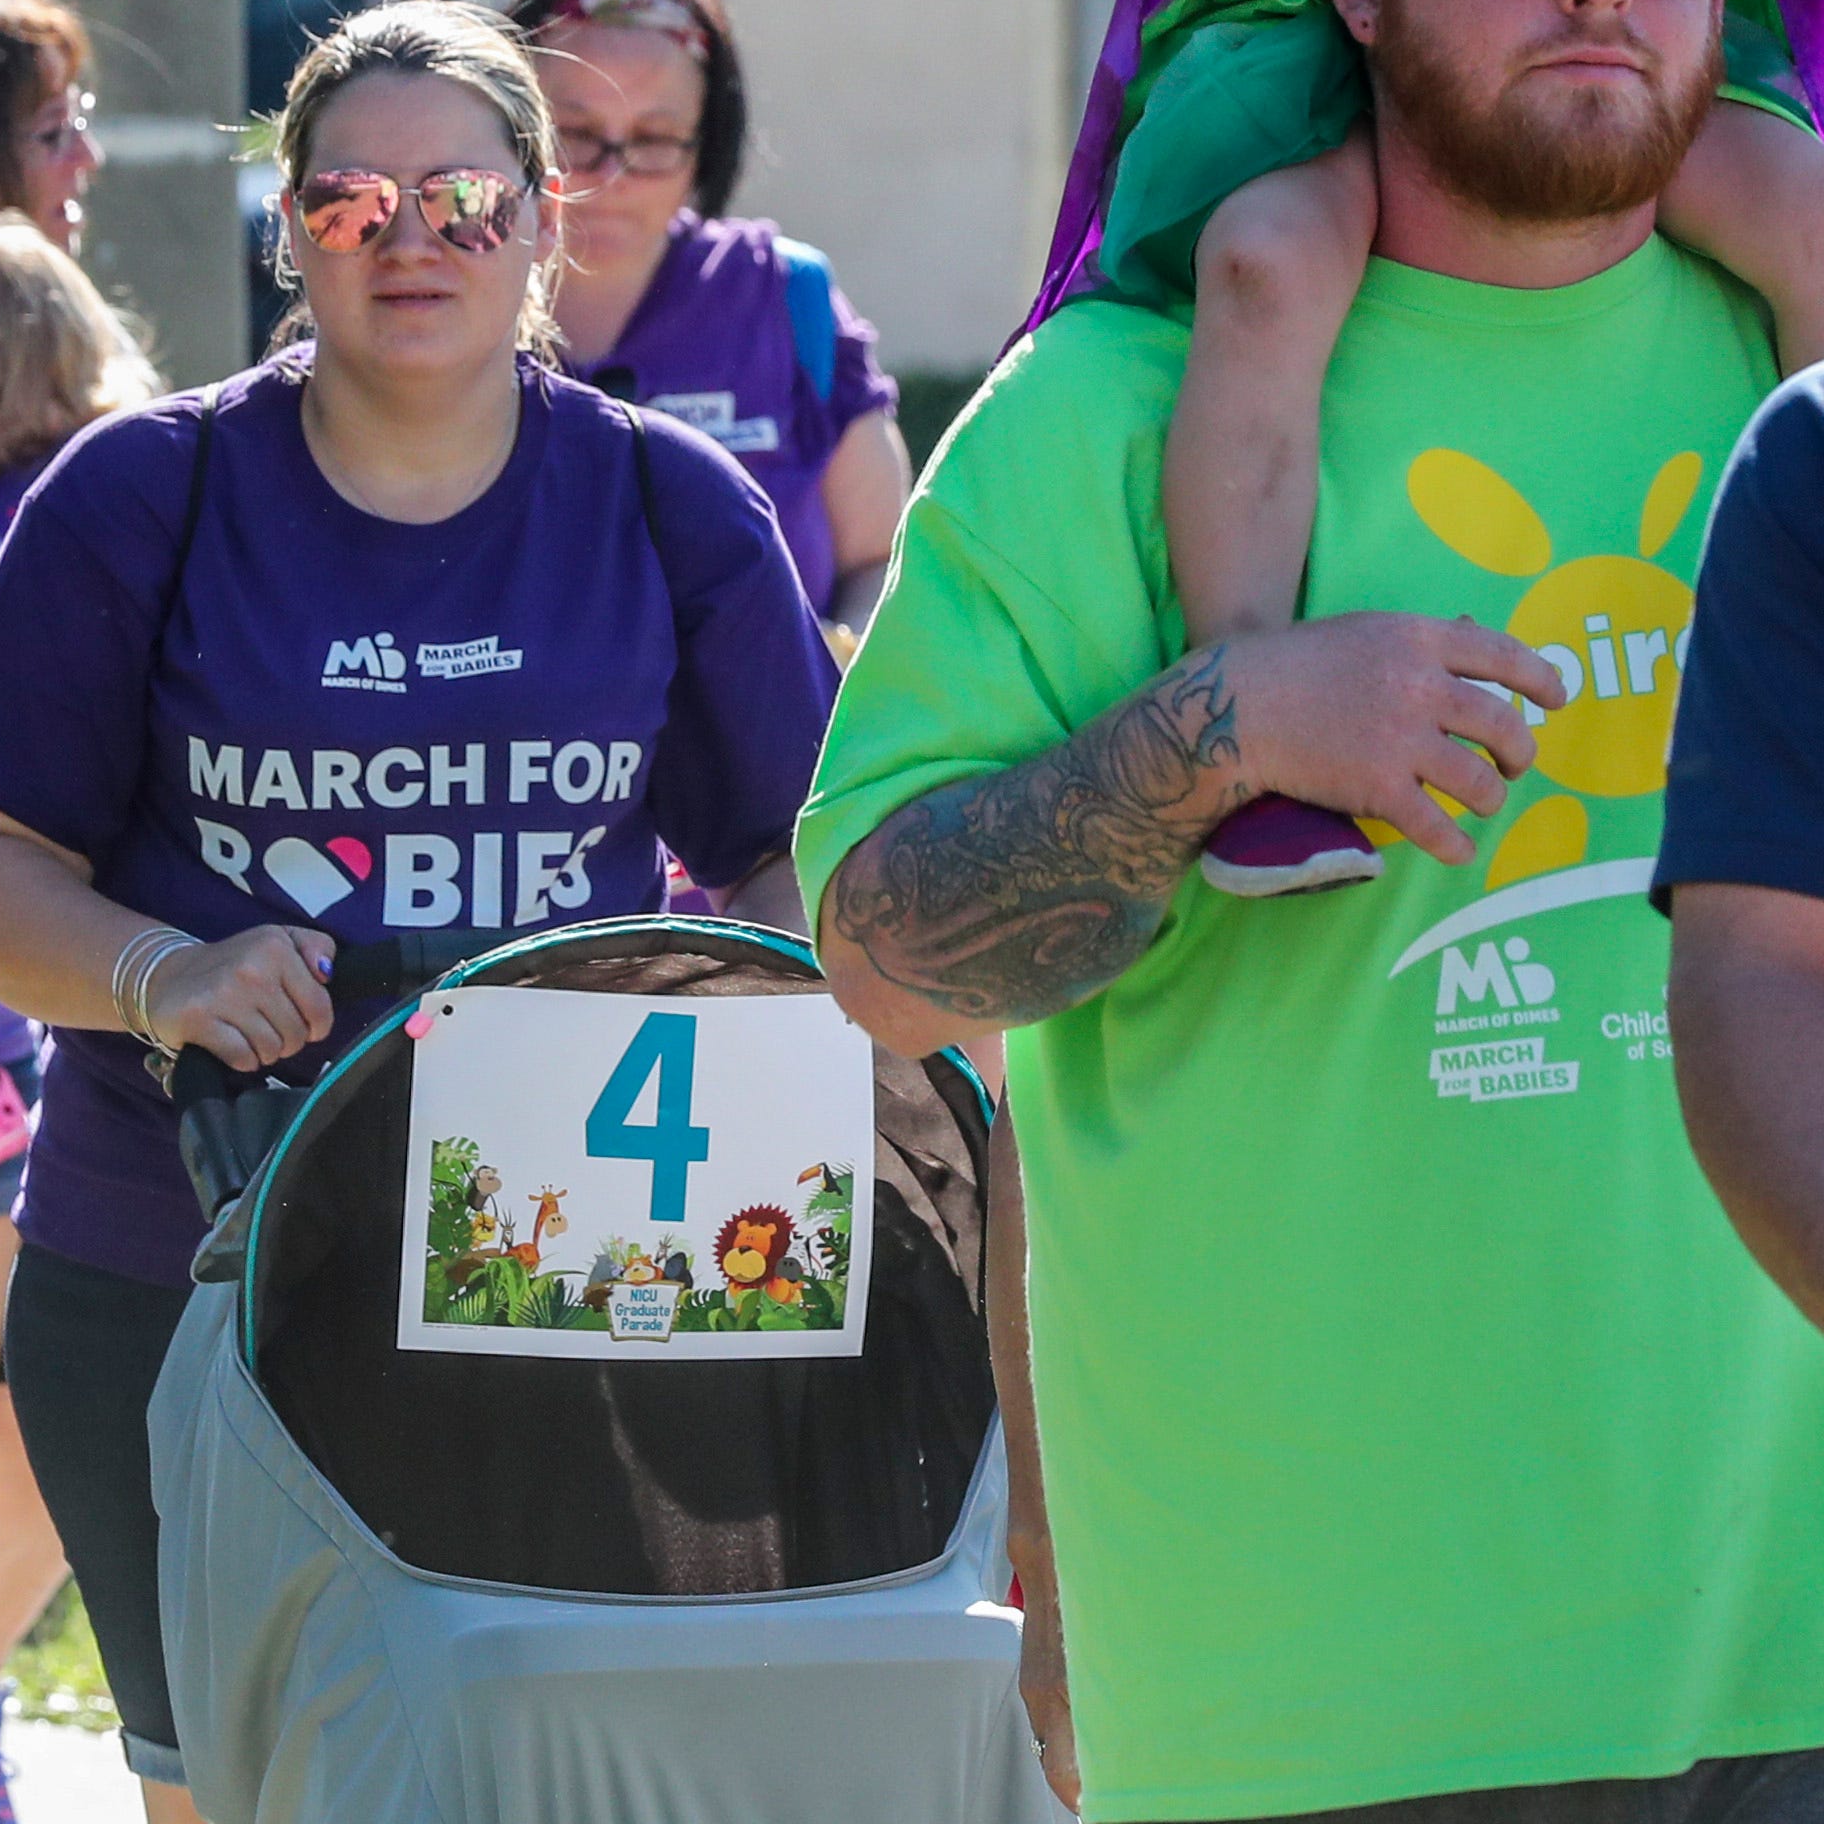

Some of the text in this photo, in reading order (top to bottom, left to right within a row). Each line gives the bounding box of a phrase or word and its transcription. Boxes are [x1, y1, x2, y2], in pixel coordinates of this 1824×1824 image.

[423, 640, 491, 662] MARCH
[426, 653, 516, 675] FOR BABIES
[321, 675, 360, 690] MARCH
[187, 734, 643, 811] MARCH FOR
[1434, 1007, 1561, 1036] MARCH OF DIMES
[1600, 1010, 1671, 1039] Child
[1438, 1042, 1535, 1074] MARCH
[1627, 1041, 1645, 1060] of
[1443, 1066, 1570, 1095] FOR BABIES
[585, 1011, 710, 1223] 4
[628, 1287, 659, 1304] NICU
[614, 1302, 671, 1319] Graduate
[620, 1317, 664, 1333] Parade
